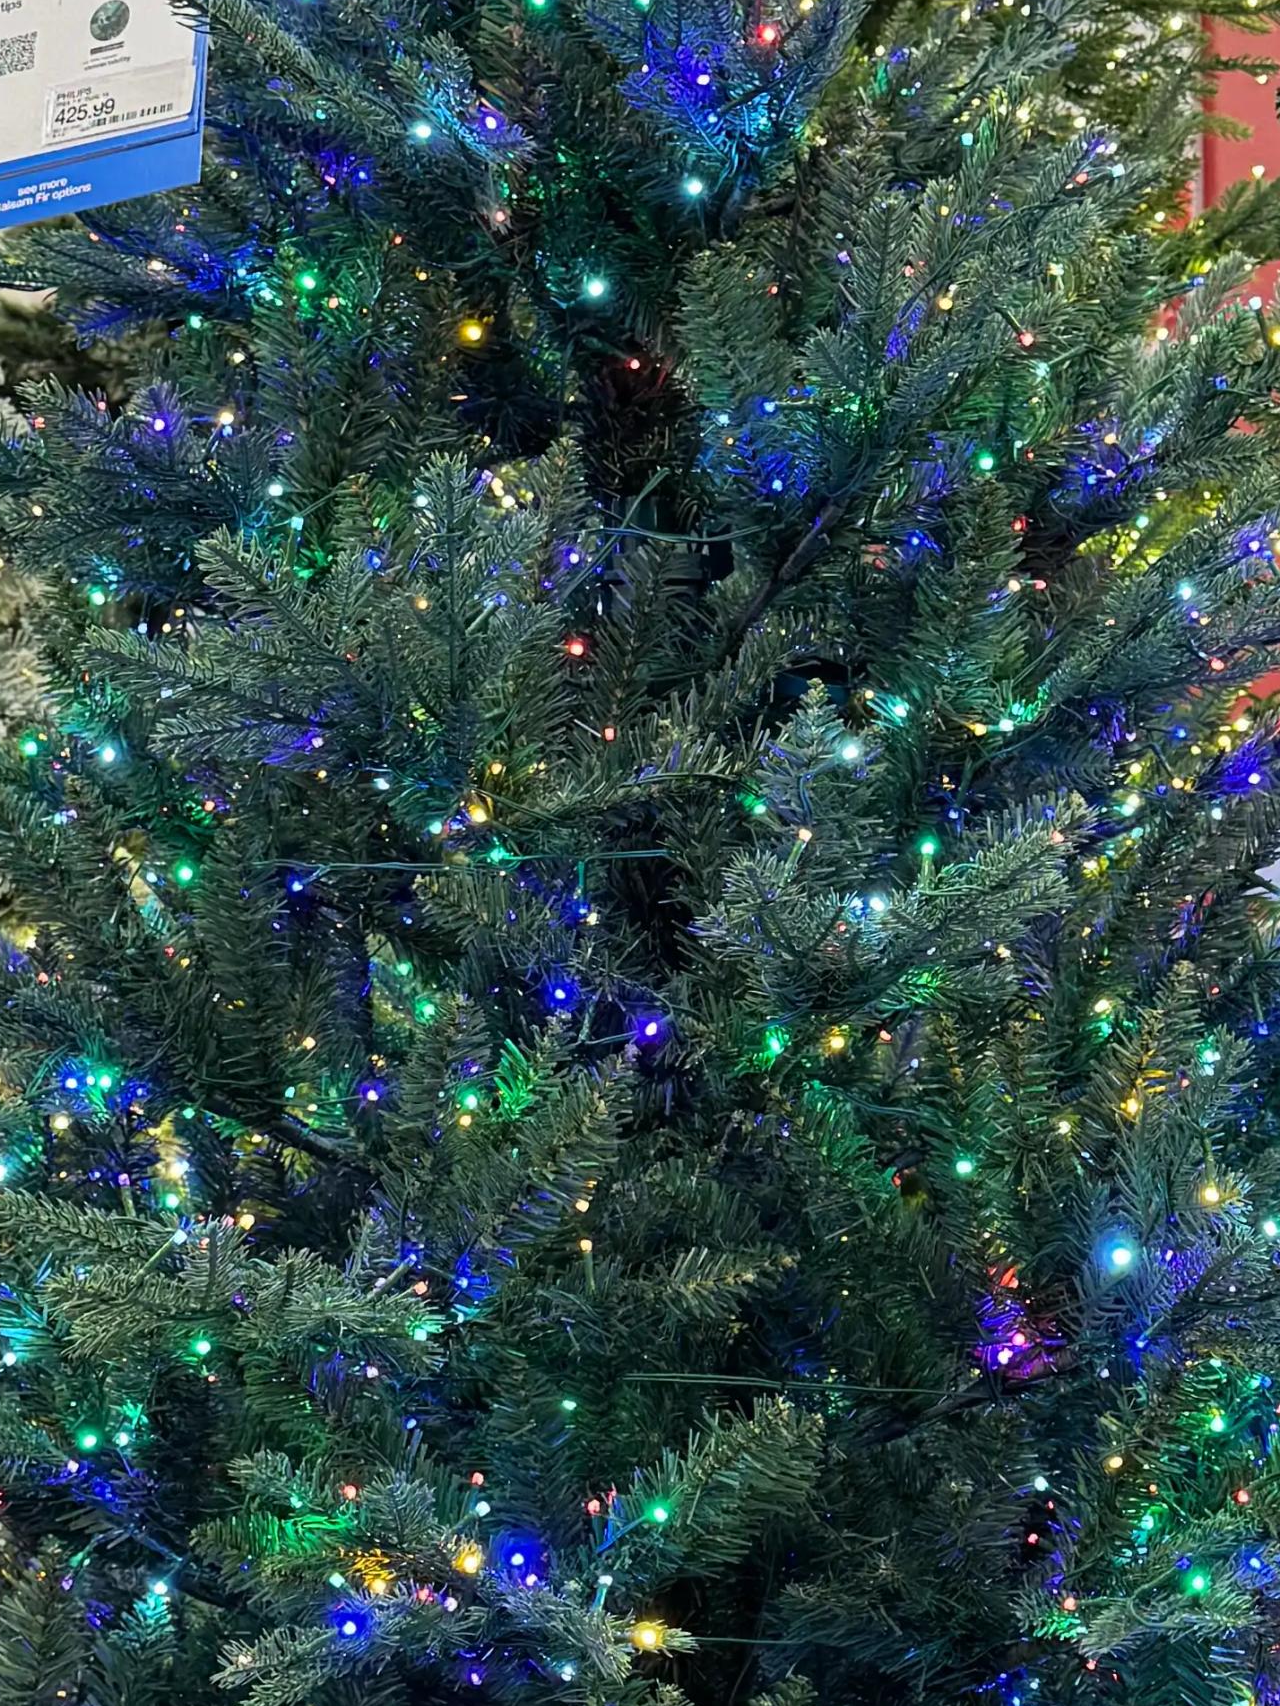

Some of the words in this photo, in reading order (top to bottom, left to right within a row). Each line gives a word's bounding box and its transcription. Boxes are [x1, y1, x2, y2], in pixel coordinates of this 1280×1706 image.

[0, 0, 23, 15] tips
[55, 98, 115, 125] 425.99
[35, 192, 50, 204] Fir
[52, 183, 92, 201] options
[39, 178, 68, 191] more
